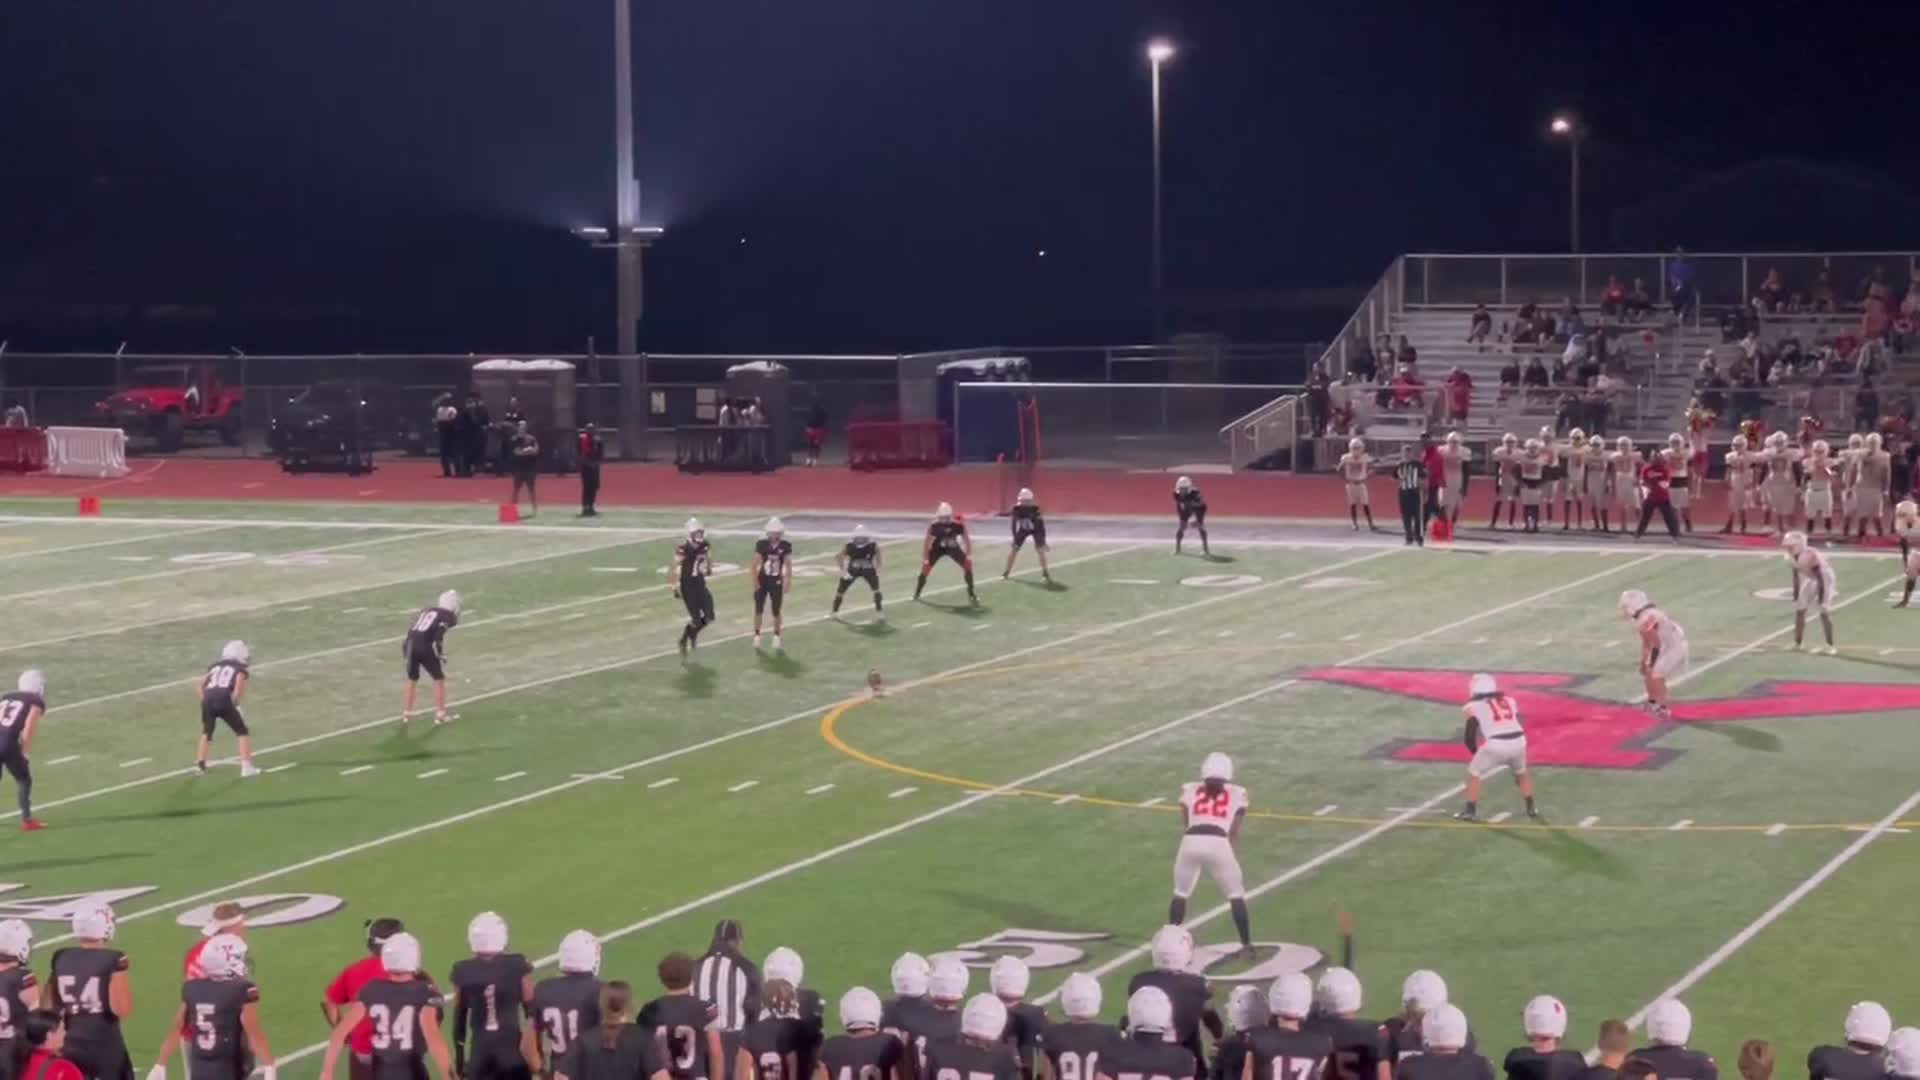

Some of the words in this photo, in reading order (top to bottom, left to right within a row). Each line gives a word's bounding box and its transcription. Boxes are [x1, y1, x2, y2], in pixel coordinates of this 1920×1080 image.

[1193, 786, 1230, 817] 22
[57, 975, 103, 1014] 54
[484, 984, 499, 1031] 1
[195, 1003, 217, 1051] 5
[369, 1004, 415, 1050] 34
[543, 1007, 580, 1053] 31
